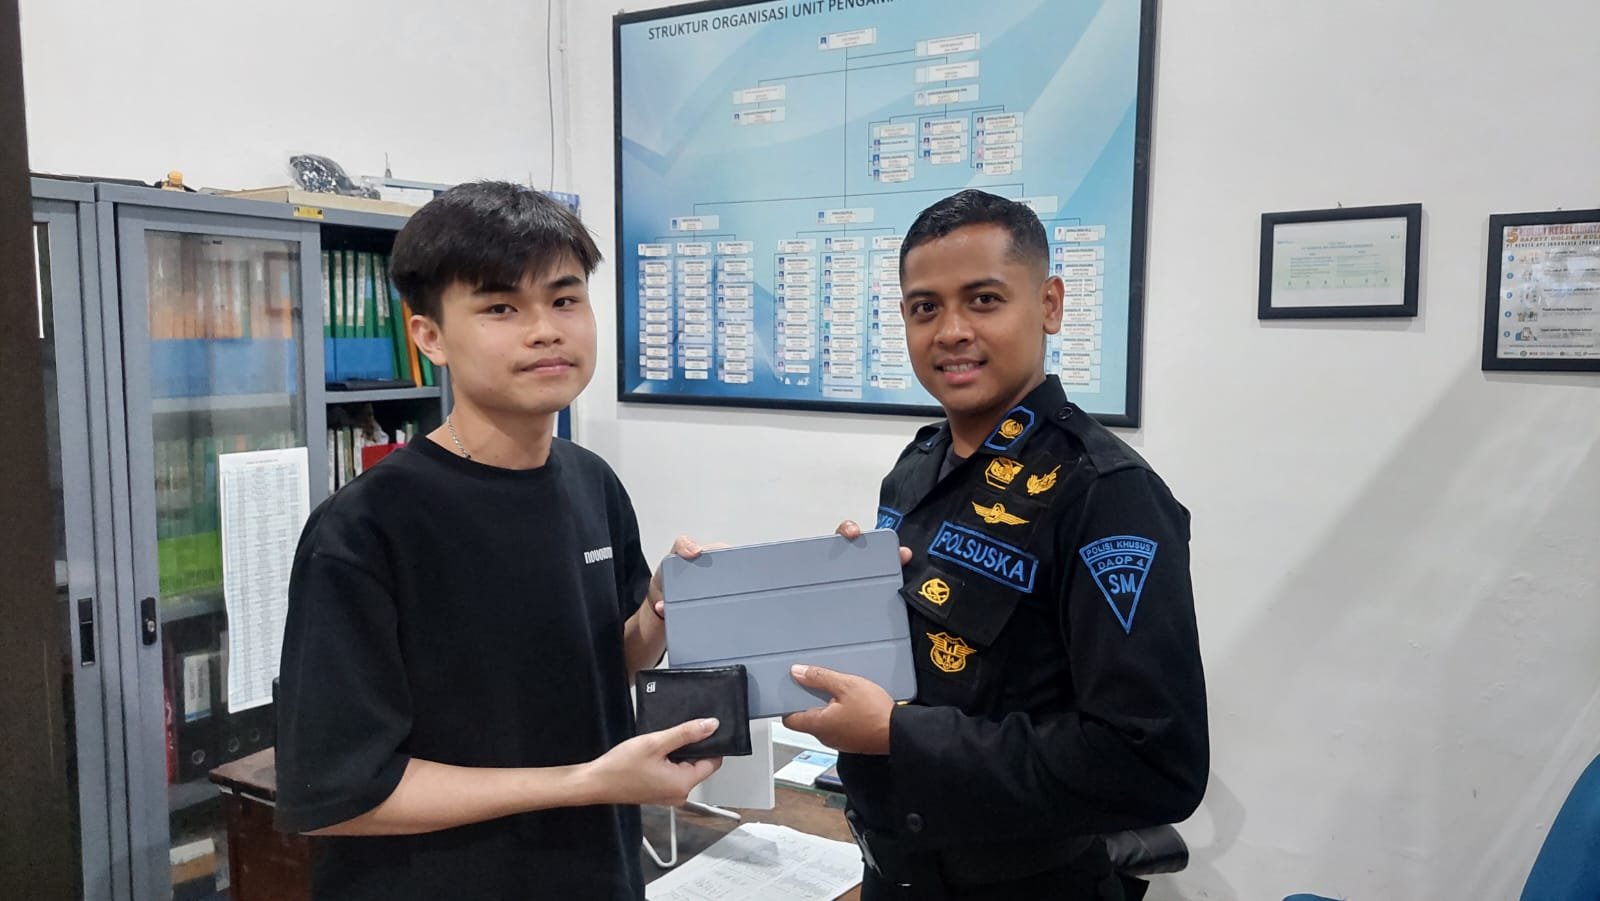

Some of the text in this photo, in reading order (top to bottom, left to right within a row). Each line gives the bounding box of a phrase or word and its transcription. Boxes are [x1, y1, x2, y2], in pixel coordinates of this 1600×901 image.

[648, 19, 709, 40] STRUKTUR
[712, 7, 789, 30] ORGANISASI
[792, 0, 825, 17] UNIT
[936, 531, 1025, 582] POLSUSKA
[1086, 540, 1151, 558] POLISI KHUSUS
[1097, 555, 1145, 570] DAOP 4
[1108, 573, 1137, 595] SM
